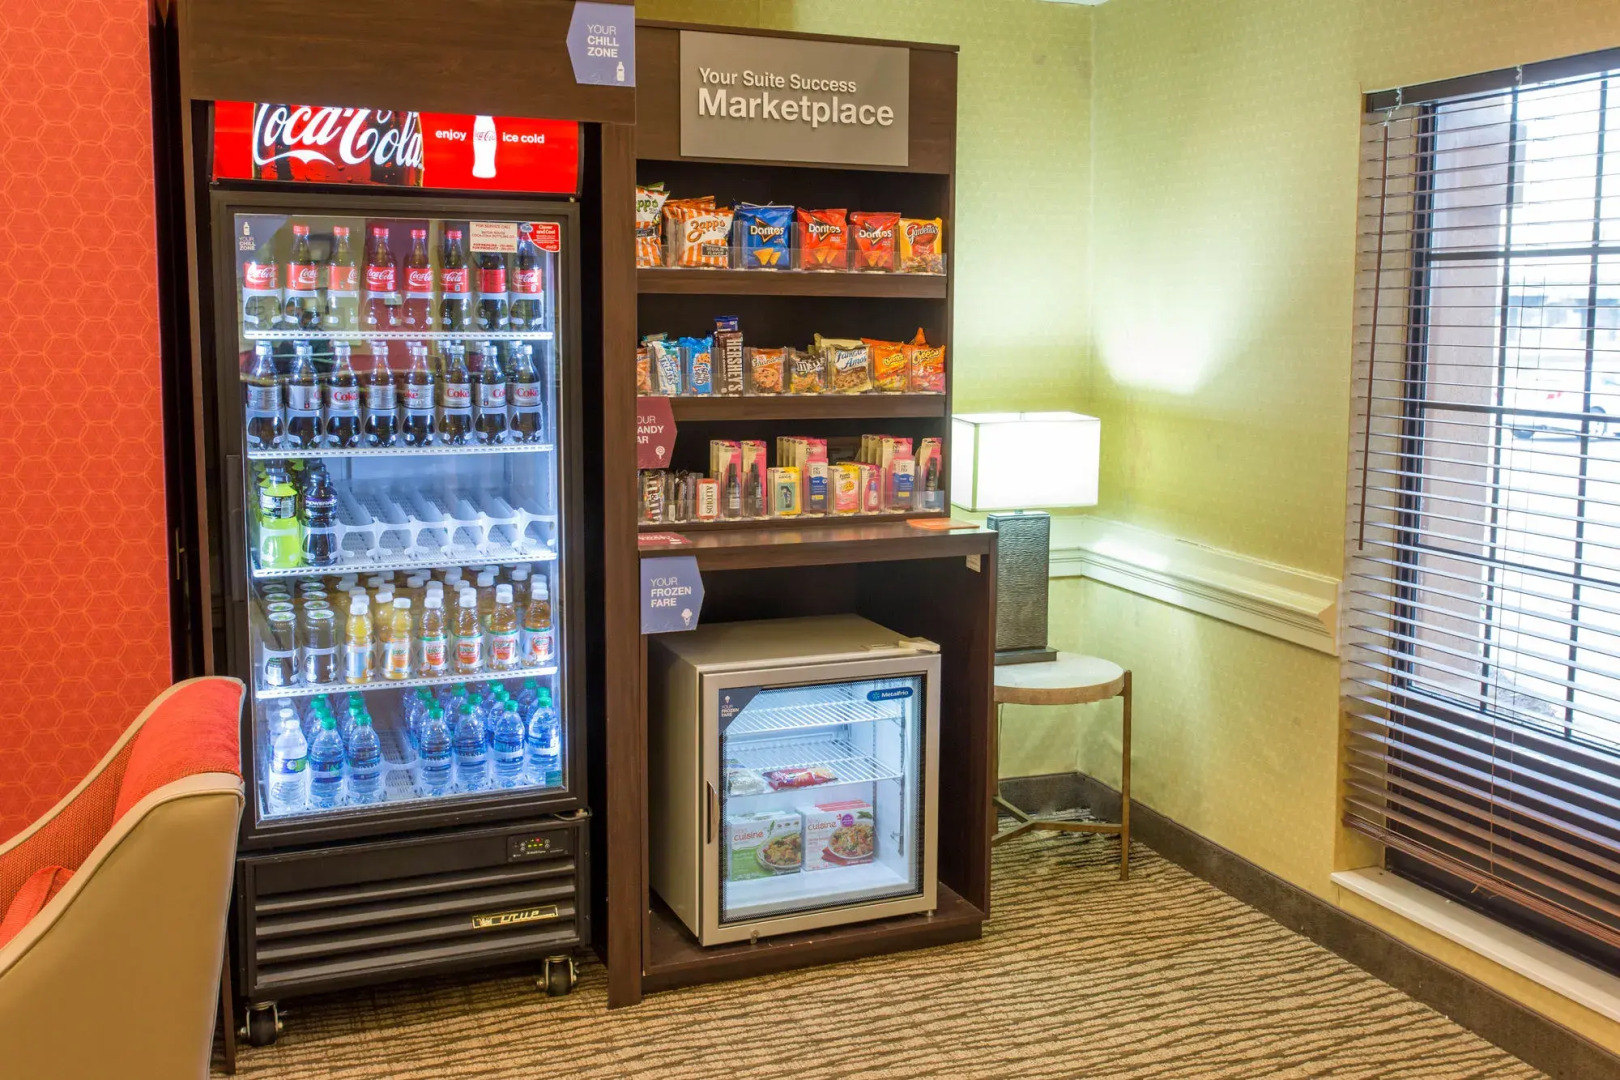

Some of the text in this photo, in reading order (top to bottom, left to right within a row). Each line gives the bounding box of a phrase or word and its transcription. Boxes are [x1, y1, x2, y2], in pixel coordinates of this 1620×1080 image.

[587, 24, 616, 35] YOUR
[587, 35, 620, 47] CHILL
[587, 46, 618, 58] ZONE
[699, 67, 857, 93] Your Suite Success
[698, 87, 895, 128] Marketplace
[435, 129, 467, 141] enjoy
[502, 132, 545, 144] ice cold
[750, 225, 785, 236] Doritos
[808, 223, 841, 234] Doritos
[858, 228, 892, 239] Doritos
[726, 339, 743, 391] HERSHEY'S
[841, 356, 867, 369] Amos
[446, 387, 470, 398] Coke
[637, 415, 656, 424] OUR
[637, 425, 664, 434] ANDY
[637, 435, 649, 444] AR
[706, 485, 714, 514] ALTOIDS
[650, 576, 678, 587] YOUR
[650, 586, 692, 597] FROZEN
[650, 597, 677, 608] FARE
